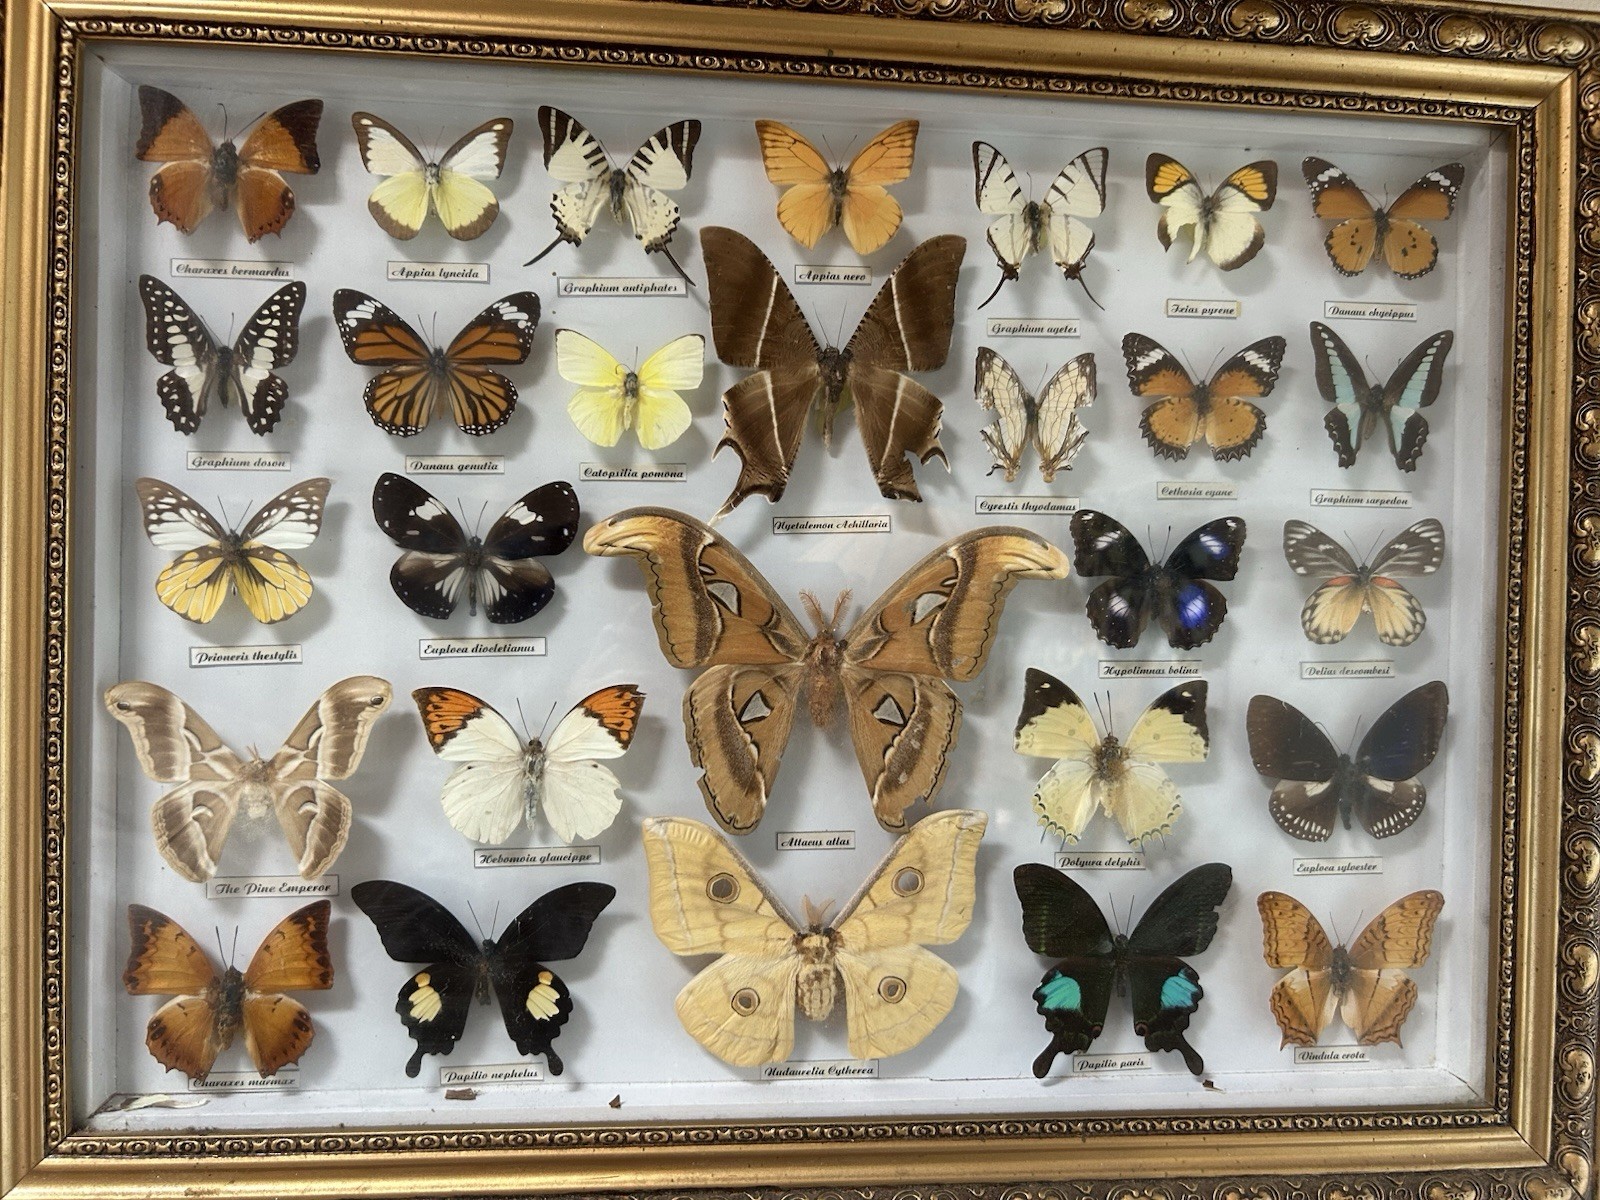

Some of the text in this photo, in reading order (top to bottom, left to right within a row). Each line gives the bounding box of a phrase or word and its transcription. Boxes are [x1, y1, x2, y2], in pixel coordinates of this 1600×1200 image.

[176, 264, 228, 275] Charaxes
[391, 266, 436, 279] Appias
[799, 271, 866, 281] Appias nero
[563, 282, 677, 294] Graphium antiphates
[1201, 307, 1234, 315] pyrene
[1328, 306, 1365, 316] Danaus
[991, 323, 1077, 335] Graphium agetes
[191, 456, 285, 468] Graphium doson
[410, 461, 498, 471] Danaus genutia
[583, 467, 683, 479] Catopsilia pomona
[1161, 486, 1202, 496] Cethosia
[1314, 493, 1408, 506] Graphium sarpedon
[979, 501, 1076, 512] Cyrestis thyodamas
[195, 650, 297, 664] Prioneris thestylis
[1103, 666, 1198, 676] Hypolimnas bolina
[1305, 667, 1336, 676] Delias
[826, 837, 850, 846] atlas
[479, 854, 537, 864] Hebomoia
[1058, 856, 1141, 867] Polyura delphis
[215, 882, 331, 895] The Pine Emperor
[1298, 1051, 1339, 1060] Vindula
[827, 1064, 874, 1075] Cytherea
[1077, 1058, 1144, 1070] Papilio paris
[444, 1069, 538, 1082] Papilio nephelus
